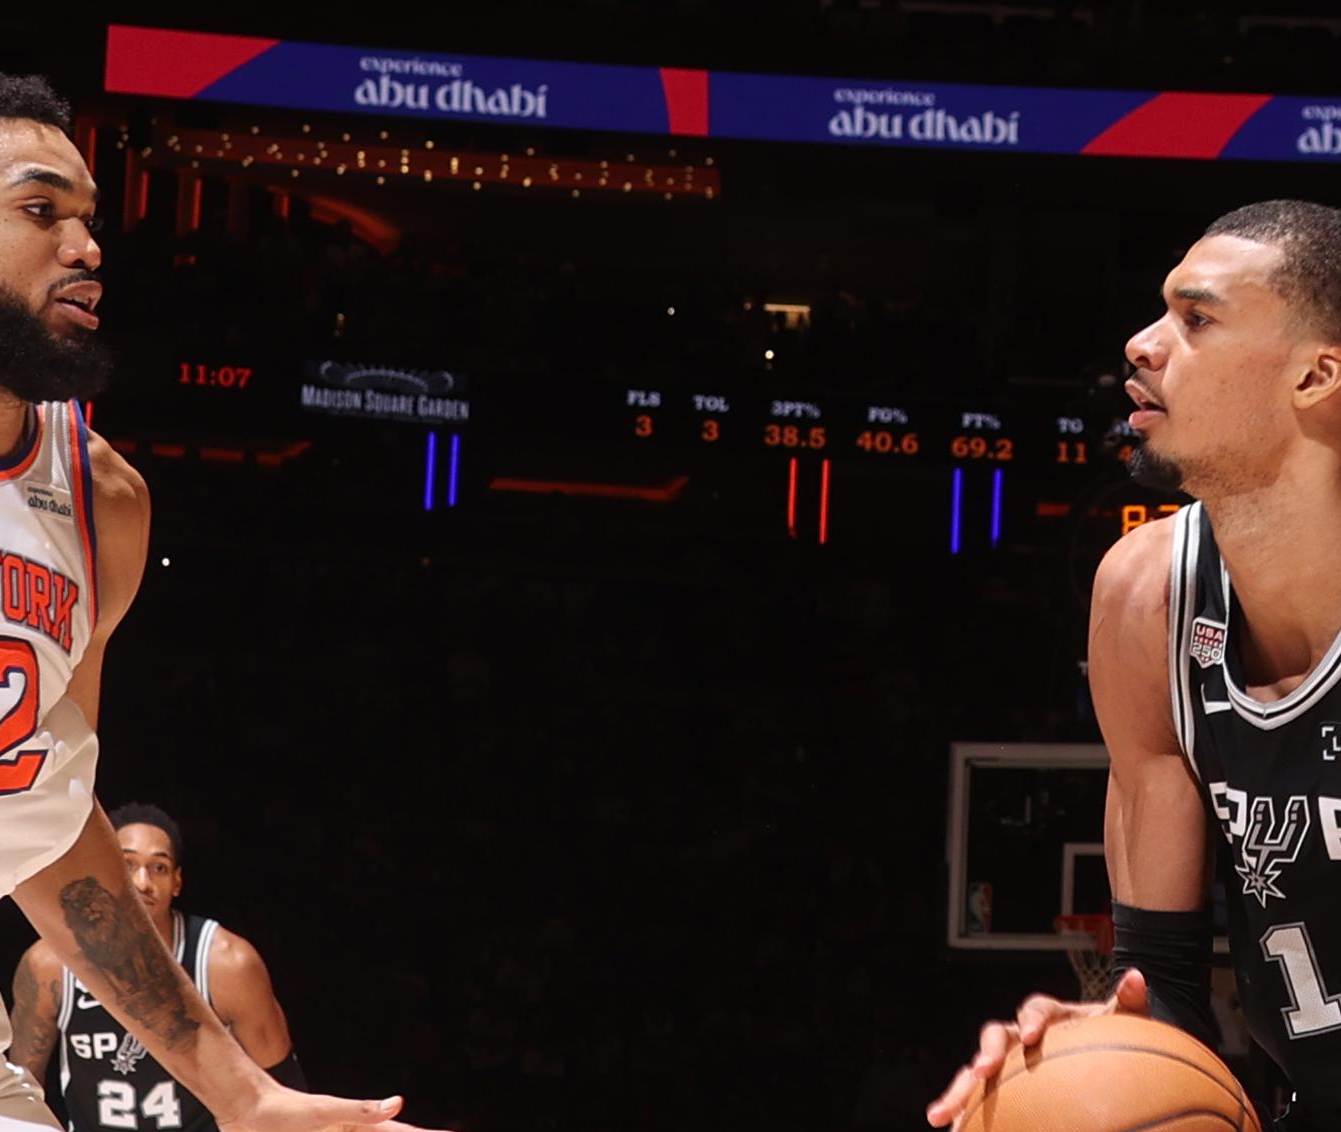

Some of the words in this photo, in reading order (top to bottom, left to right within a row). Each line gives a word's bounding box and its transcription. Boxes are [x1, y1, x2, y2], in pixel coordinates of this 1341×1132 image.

[359, 56, 462, 78] experience
[355, 77, 429, 110] abu
[436, 81, 547, 118] dhabi
[834, 88, 935, 106] experience
[829, 105, 903, 139] abu
[909, 105, 1019, 144] dhabi
[179, 362, 252, 388] 11:07
[300, 384, 362, 409] MADISON
[364, 388, 416, 416] SQUARE
[417, 392, 470, 420] GARDEN
[627, 390, 661, 407] FLS
[694, 394, 730, 412] TOL
[772, 400, 820, 418] 3PT%
[867, 406, 908, 423] FG%
[962, 412, 1001, 429] FT%
[635, 415, 653, 437] 3
[702, 419, 720, 442] 3
[765, 424, 826, 449] 38.5
[857, 431, 919, 455] 40.6
[951, 436, 1013, 461] 69.2
[1058, 441, 1088, 463] 11
[1192, 641, 1222, 660] 250
[1196, 624, 1223, 641] USA
[96, 1078, 182, 1131] 24
